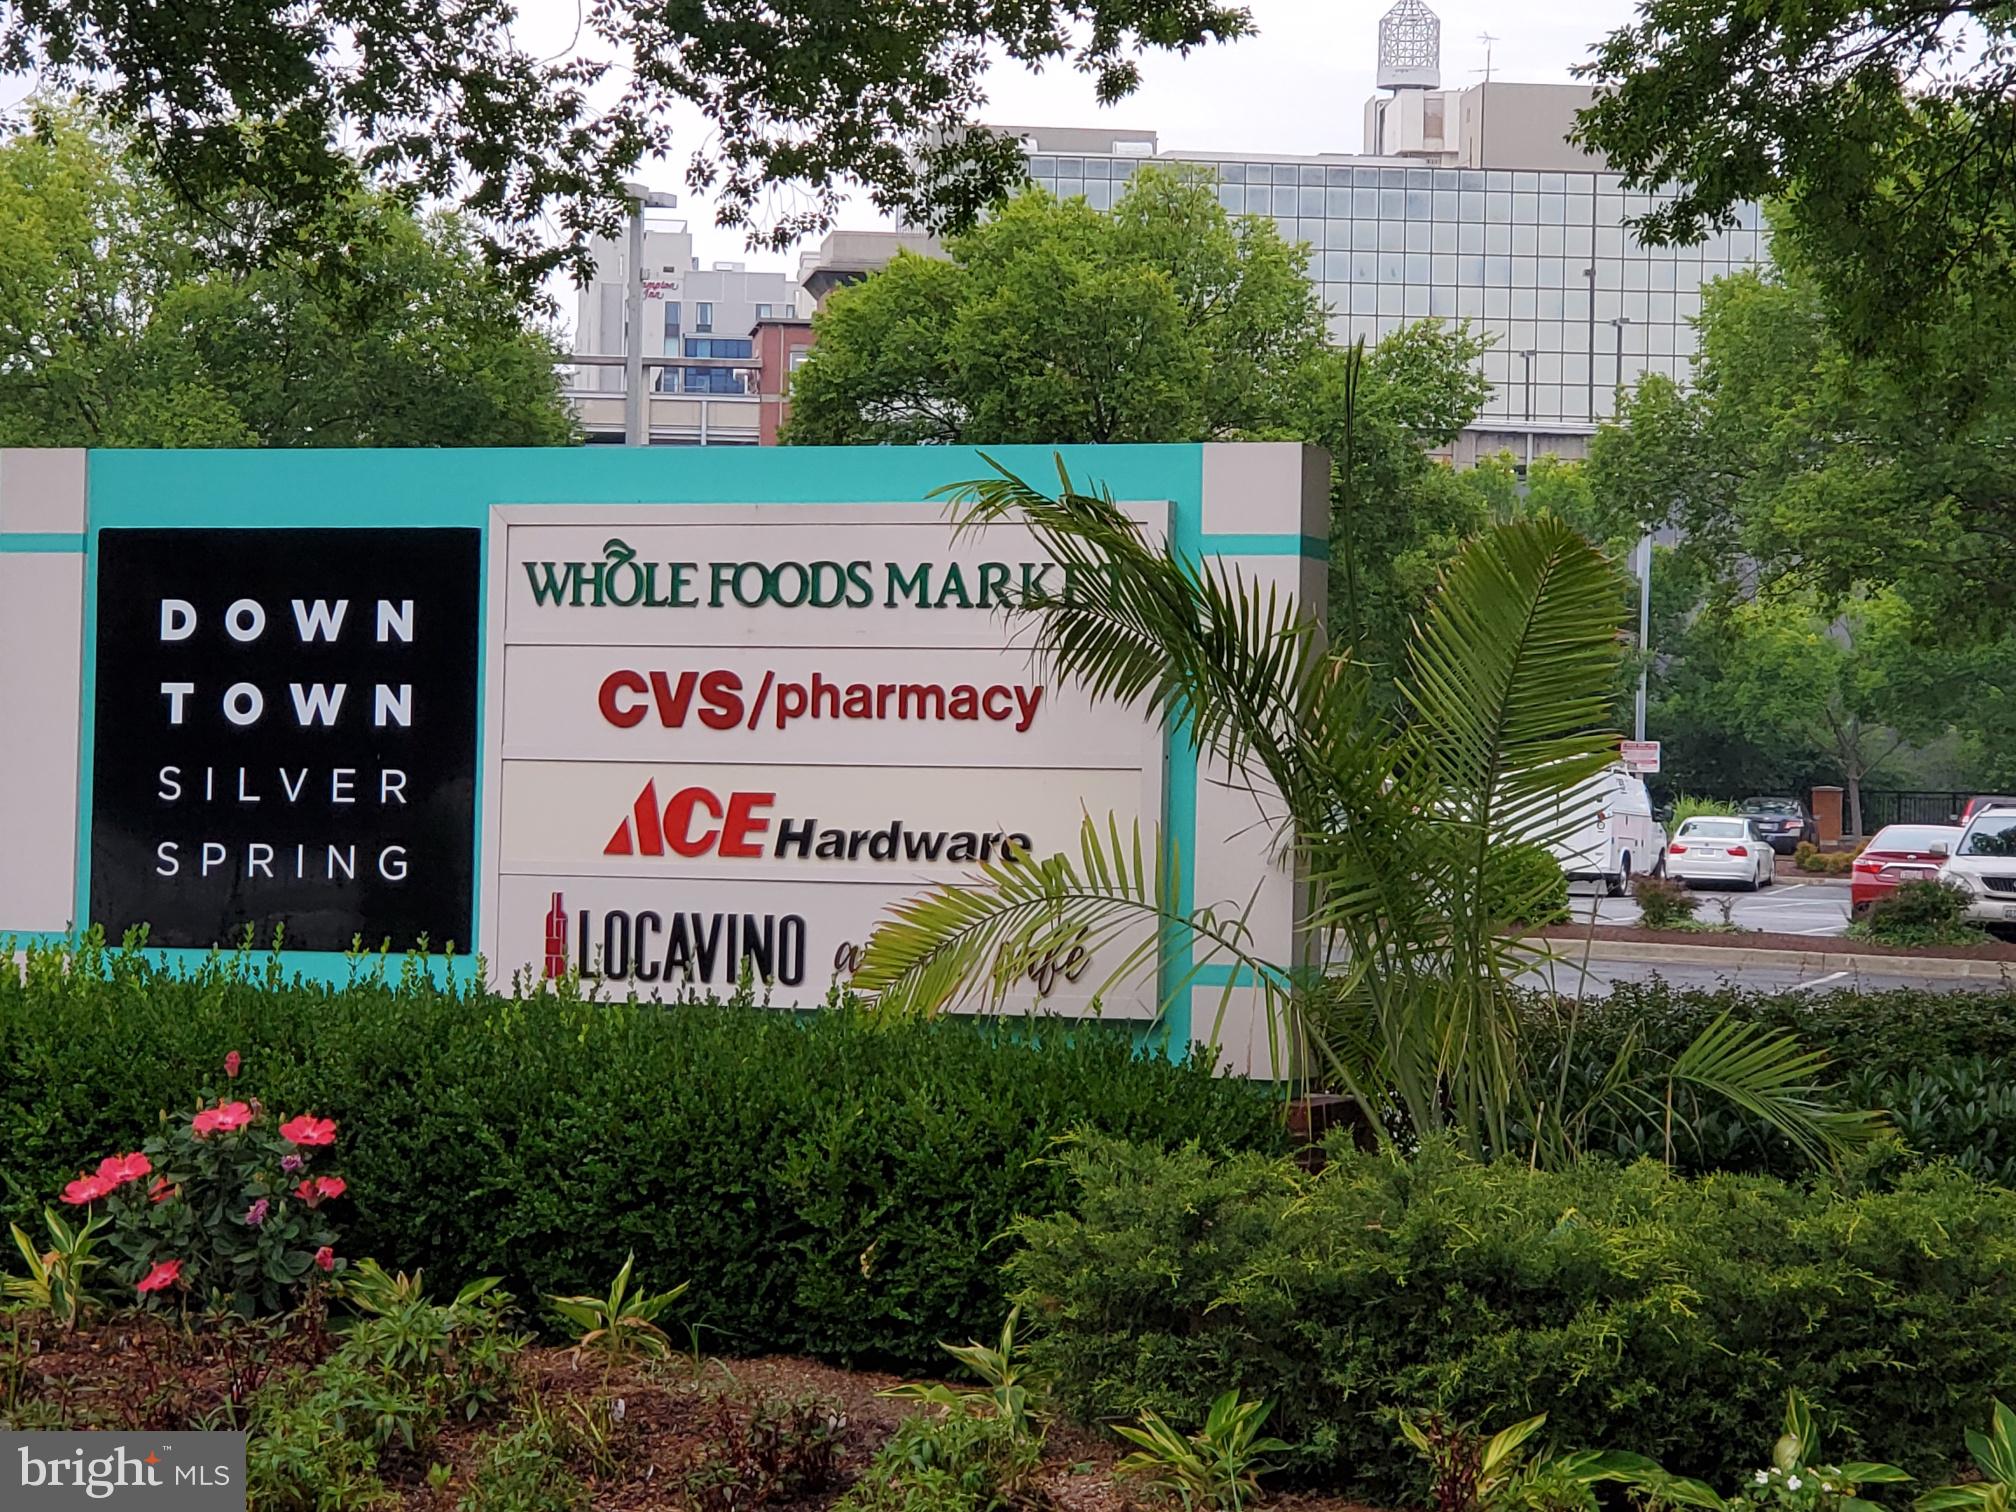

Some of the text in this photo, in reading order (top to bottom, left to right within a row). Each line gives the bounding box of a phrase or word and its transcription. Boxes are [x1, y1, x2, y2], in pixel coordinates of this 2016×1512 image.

[523, 539, 698, 608] WHOLE
[709, 561, 871, 608] FOODS
[160, 598, 414, 643] DOWN
[160, 681, 412, 727] TOWN
[598, 669, 1044, 732] CVS/pharmacy
[157, 765, 408, 804] SILVER
[604, 776, 1033, 863] ACE Hardware
[156, 840, 409, 881] SPRING
[578, 909, 807, 986] LOCAVINO
